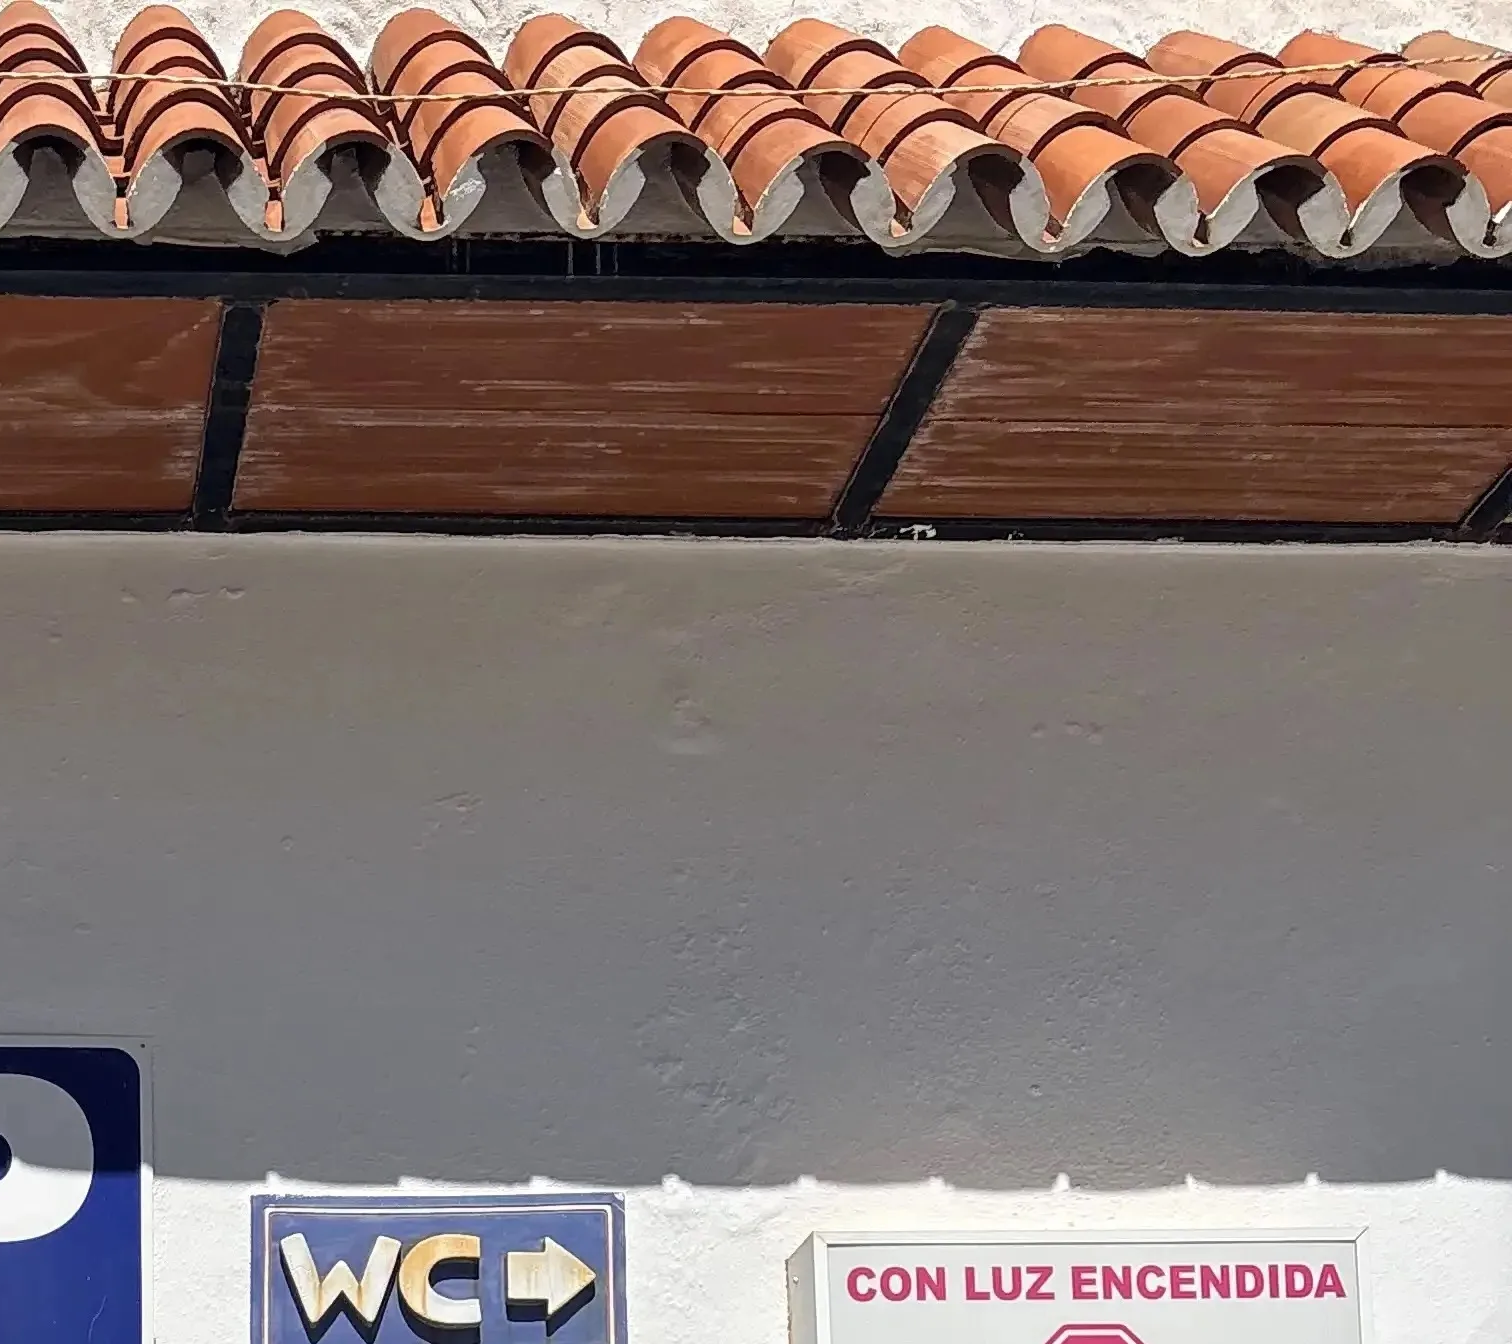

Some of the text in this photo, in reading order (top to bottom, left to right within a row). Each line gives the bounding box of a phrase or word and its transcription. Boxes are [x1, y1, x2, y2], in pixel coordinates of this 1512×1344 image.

[279, 1231, 481, 1334] WC
[846, 1263, 1346, 1303] CON LUZ ENCENDIDA
